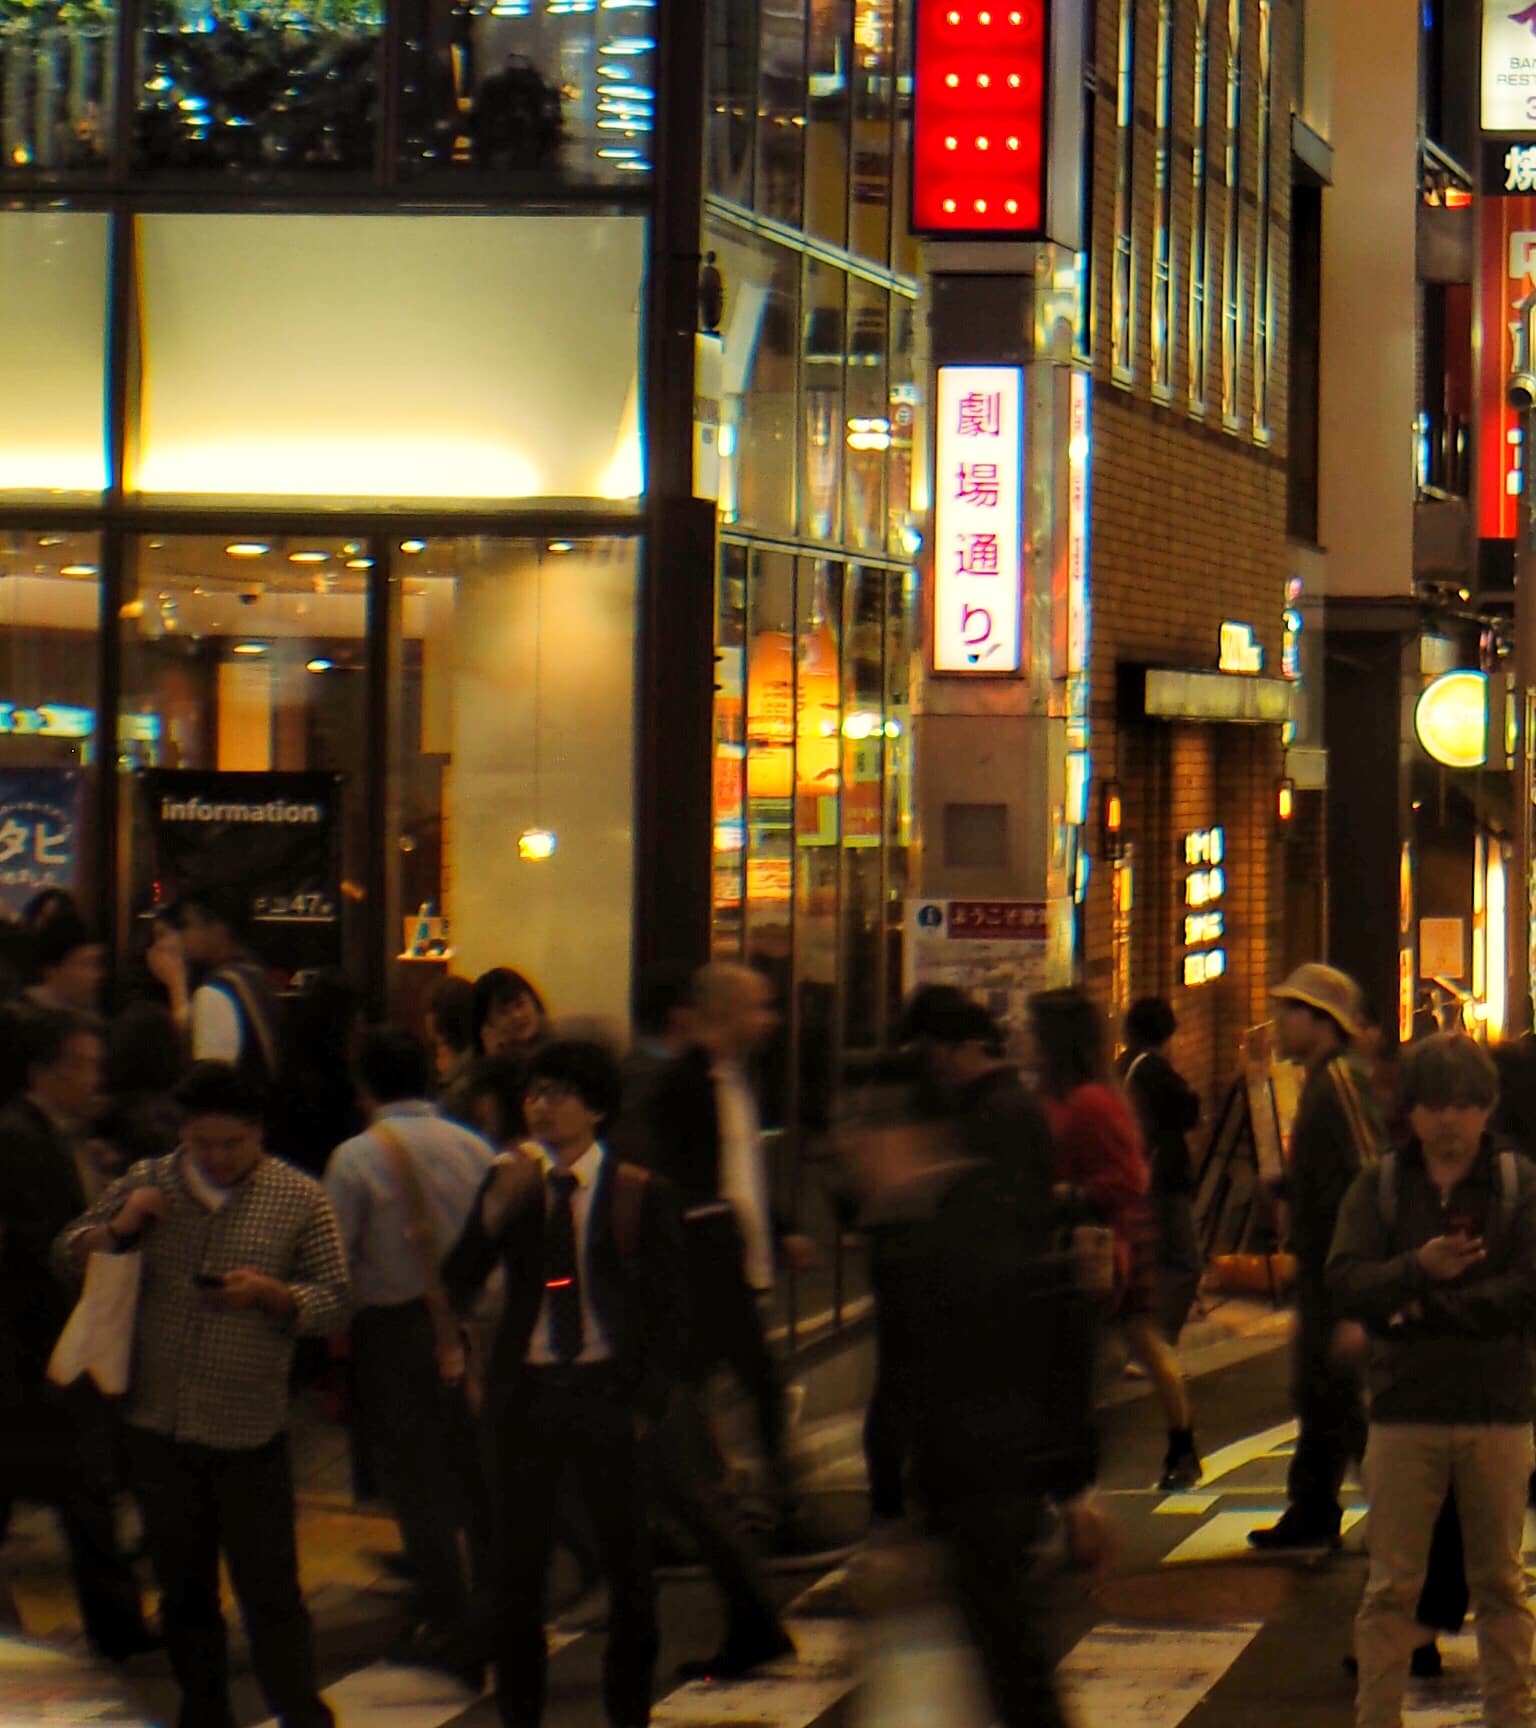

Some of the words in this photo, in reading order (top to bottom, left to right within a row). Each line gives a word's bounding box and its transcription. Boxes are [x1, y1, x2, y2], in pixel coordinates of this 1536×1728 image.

[954, 390, 1004, 651] 劇場通り
[162, 797, 320, 823] information
